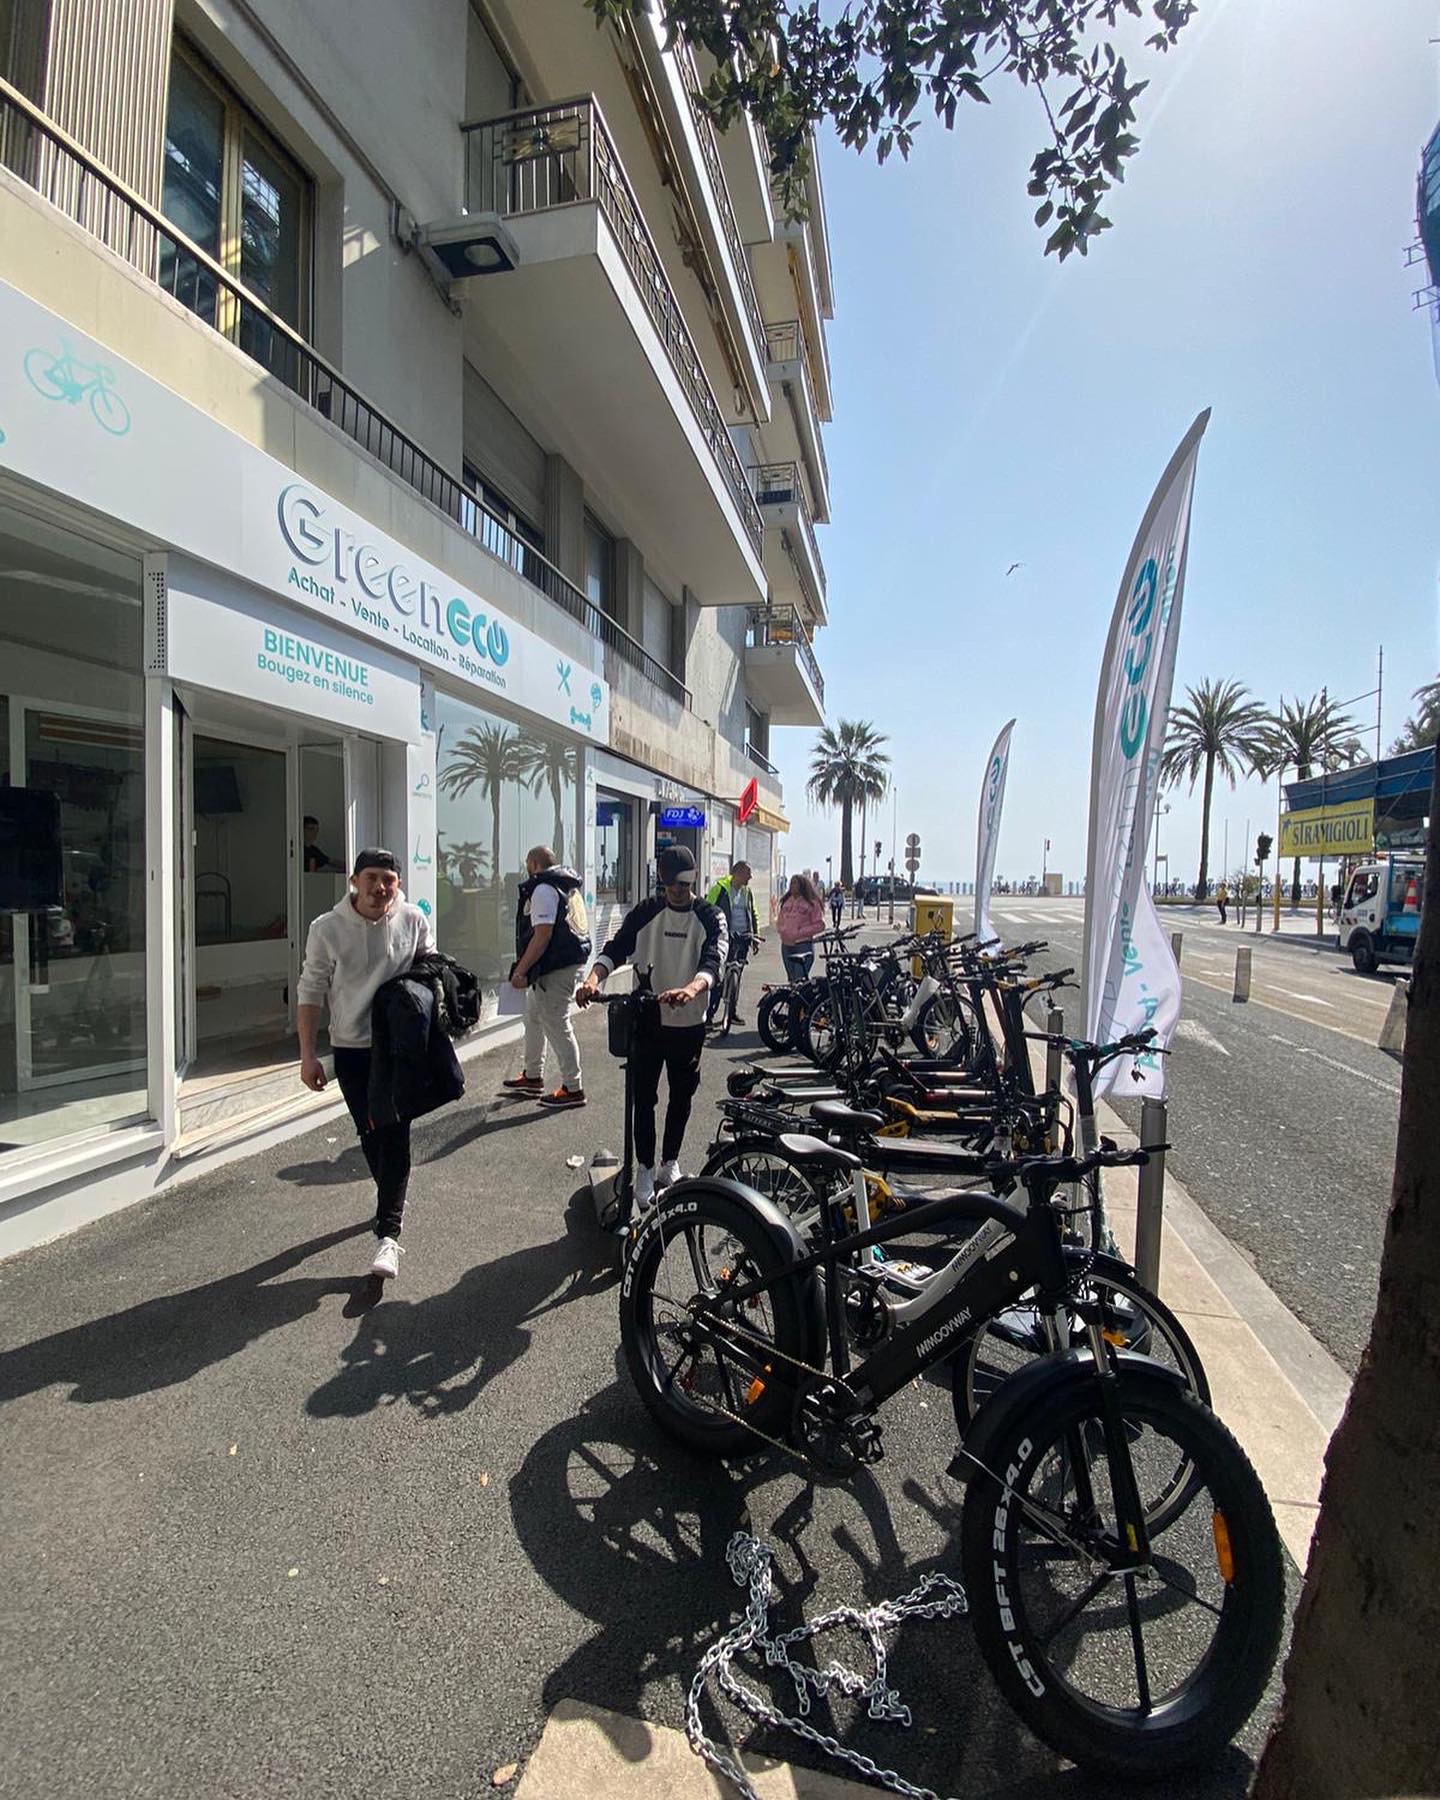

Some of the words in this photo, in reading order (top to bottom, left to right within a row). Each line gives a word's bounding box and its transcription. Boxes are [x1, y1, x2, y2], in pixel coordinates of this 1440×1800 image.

[288, 567, 335, 604] Achat
[351, 597, 389, 631] Vente
[402, 624, 449, 660] Location
[458, 653, 507, 689] Réparation
[257, 653, 311, 683] Bougez
[313, 675, 330, 690] en
[332, 680, 374, 705] silence
[264, 629, 369, 687] BIENVENUE
[666, 810, 685, 818] FDJ
[623, 1261, 635, 1298] CST
[632, 1227, 650, 1262] BFT
[993, 1560, 1017, 1631] BFT
[1008, 1641, 1046, 1697] CST
